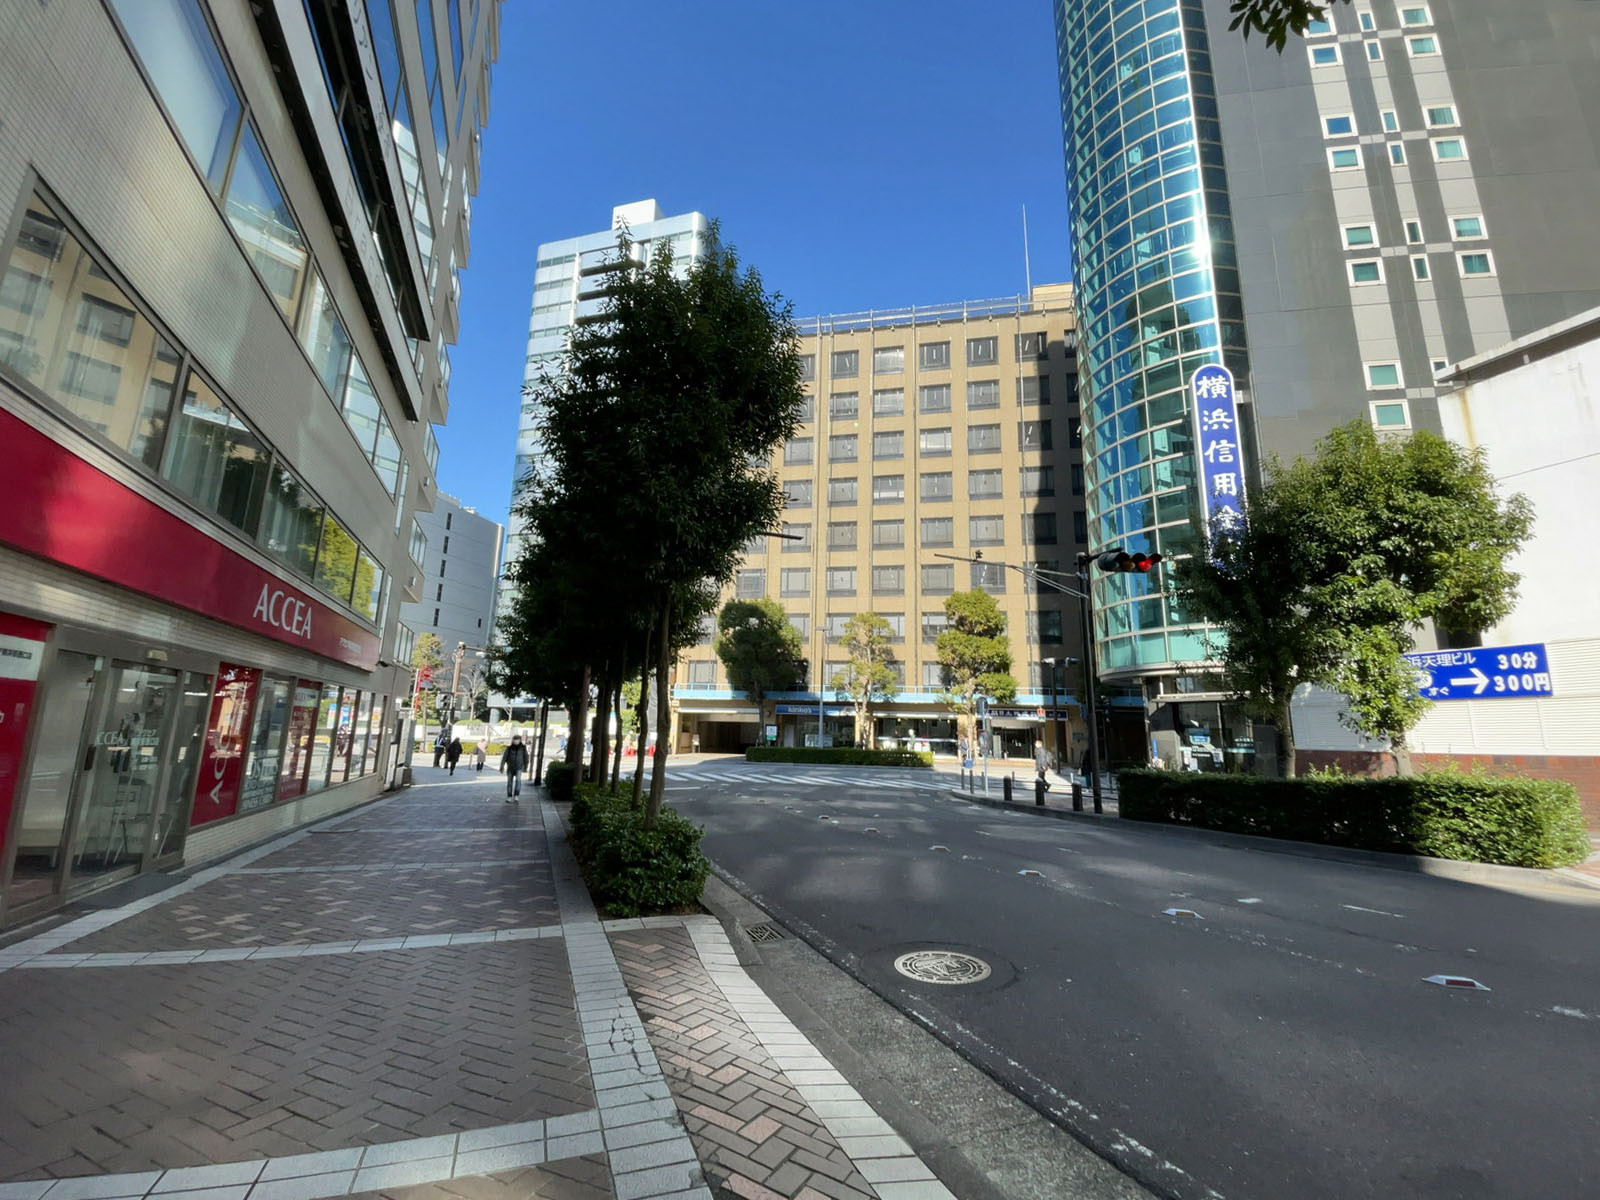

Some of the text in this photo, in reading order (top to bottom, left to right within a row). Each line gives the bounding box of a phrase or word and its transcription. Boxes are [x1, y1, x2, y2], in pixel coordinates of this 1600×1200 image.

[1197, 375, 1243, 533] 横浜信用金
[252, 583, 312, 639] ACCEA
[1405, 652, 1477, 668] 浜天理ビル
[1497, 651, 1537, 670] 30分
[1492, 672, 1551, 692] 300円
